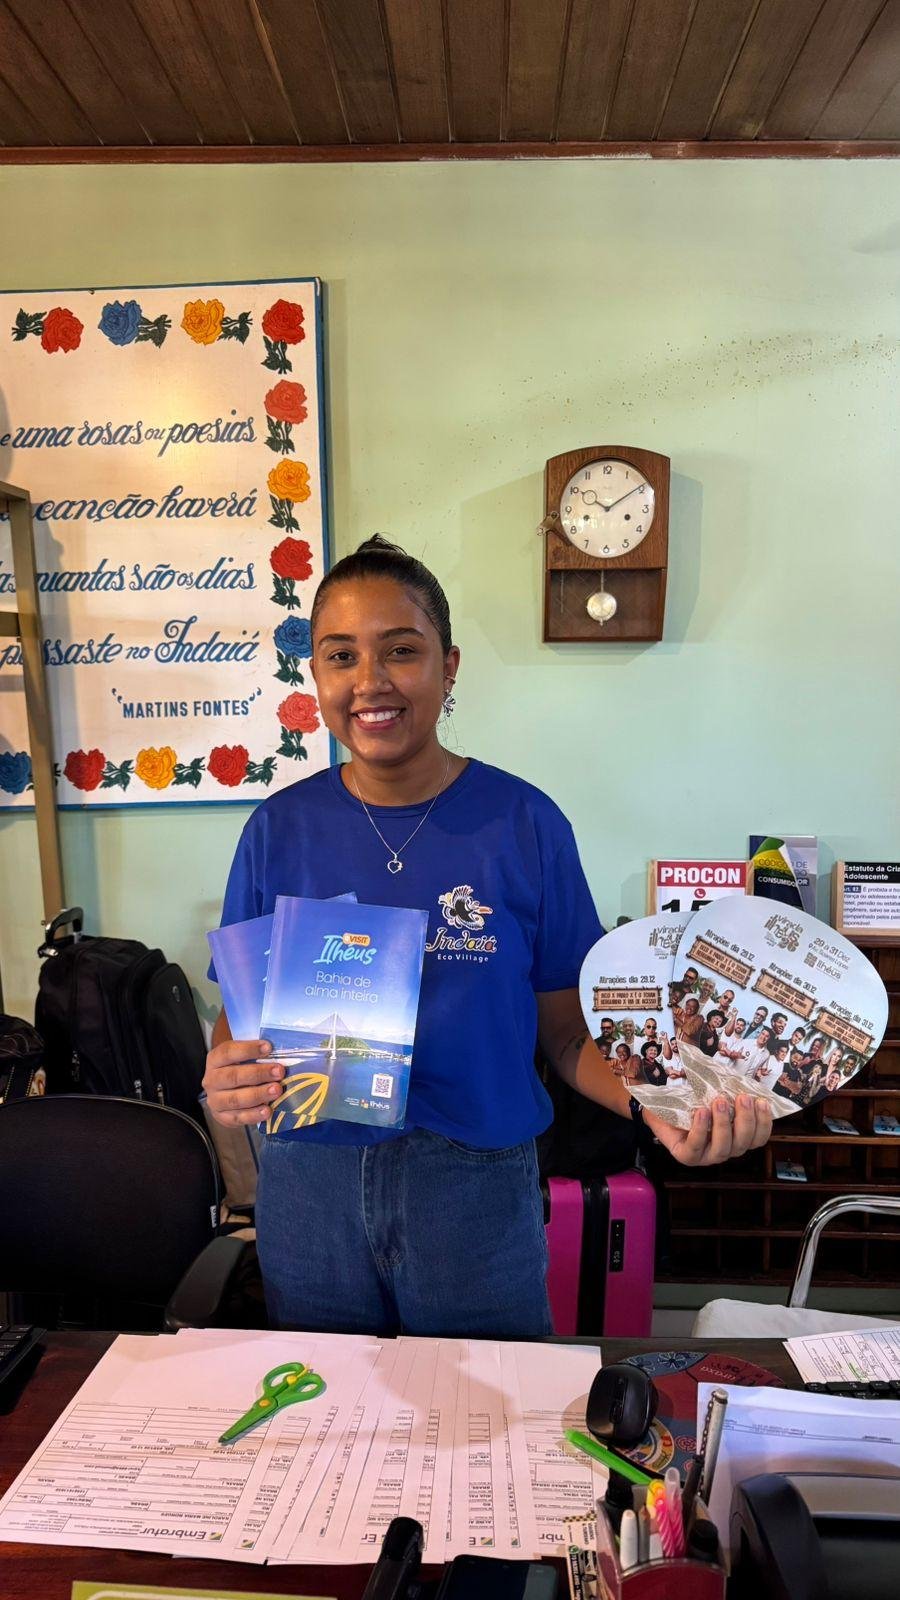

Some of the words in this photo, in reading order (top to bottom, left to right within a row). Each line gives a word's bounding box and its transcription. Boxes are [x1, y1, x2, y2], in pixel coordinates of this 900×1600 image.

[12, 425, 75, 448] uma
[77, 421, 145, 446] rosas
[145, 428, 165, 440] ou
[157, 409, 257, 457] poesias
[602, 465, 613, 475] 12
[624, 470, 630, 480] 1
[584, 471, 591, 481] 11
[570, 486, 580, 495] 10
[637, 485, 645, 494] 2
[33, 493, 157, 524] canção
[155, 485, 257, 518] haverá
[564, 505, 573, 514] 9
[641, 504, 650, 514] 3
[570, 525, 578, 535] 8
[635, 525, 643, 533] 4
[583, 539, 590, 549] 7
[602, 544, 610, 554] 6
[621, 539, 630, 549] 5
[130, 564, 176, 592] são
[176, 574, 195, 590] os
[192, 556, 257, 591] dias
[125, 645, 154, 660] no
[153, 616, 261, 664] Indaiá
[660, 867, 740, 884] PROCON
[349, 935, 370, 945] VISIT
[424, 927, 497, 953] Indaiá
[313, 934, 377, 966] Ilhéus
[455, 953, 489, 963] Village
[315, 970, 353, 987] Bahia
[354, 977, 372, 989] de
[599, 976, 627, 985] Atrações
[628, 975, 639, 983] dia
[305, 984, 338, 1000] alma
[340, 989, 378, 1005] inteira
[142, 1527, 206, 1540] Embratur
